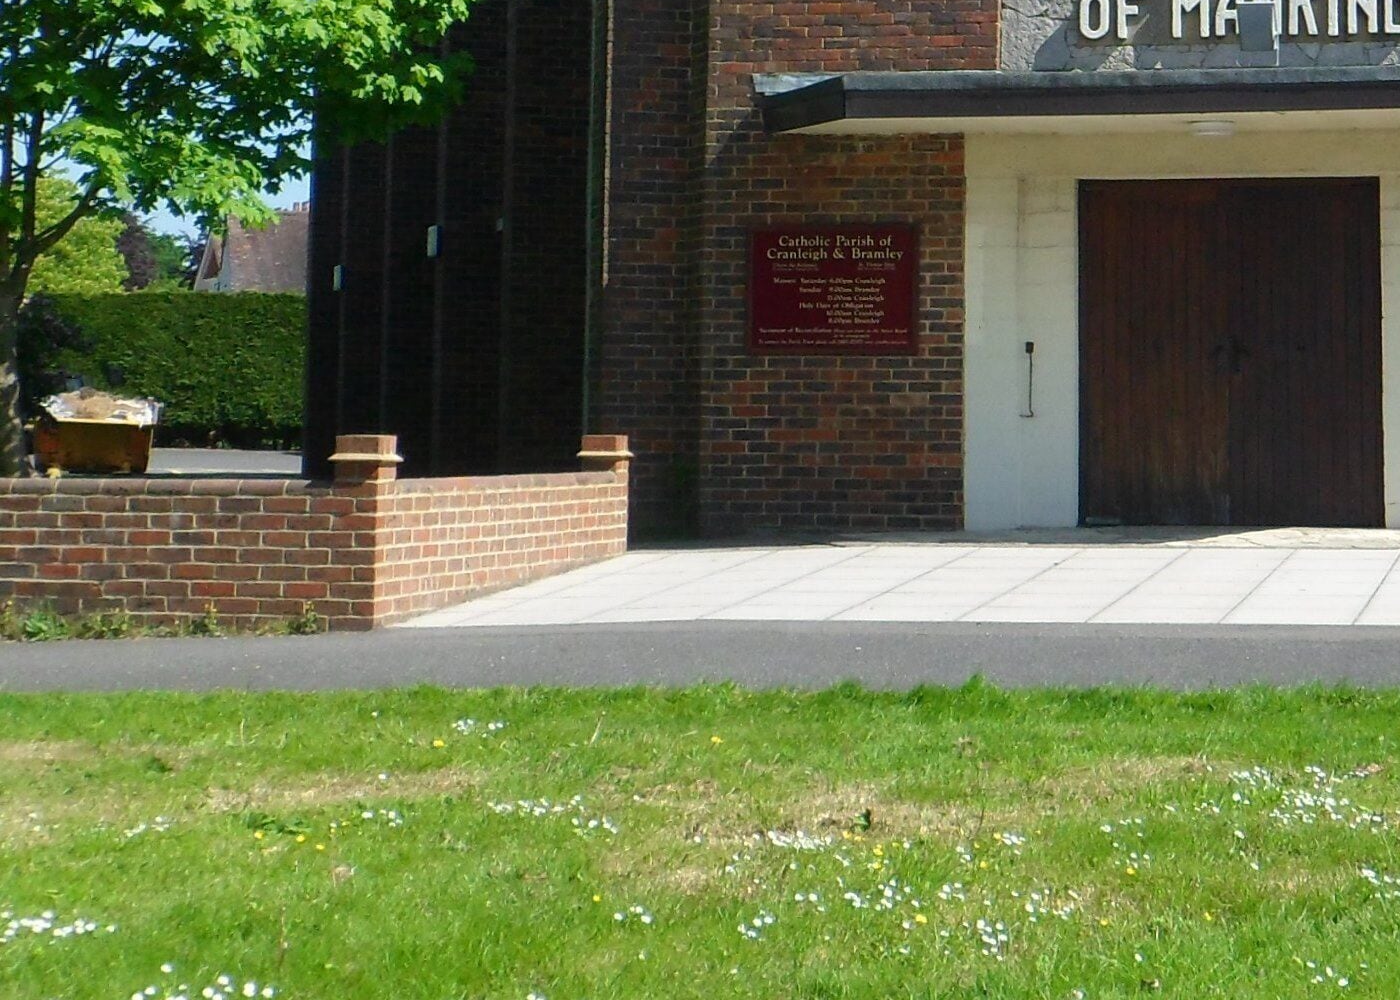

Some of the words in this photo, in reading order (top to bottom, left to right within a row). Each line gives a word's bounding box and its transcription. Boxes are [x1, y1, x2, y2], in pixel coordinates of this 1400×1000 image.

[778, 235, 831, 247] Catholic
[836, 235, 874, 247] Parish
[879, 235, 892, 247] of
[766, 247, 828, 261] Cranleigh
[832, 248, 846, 259] &
[851, 247, 904, 261] Bramley
